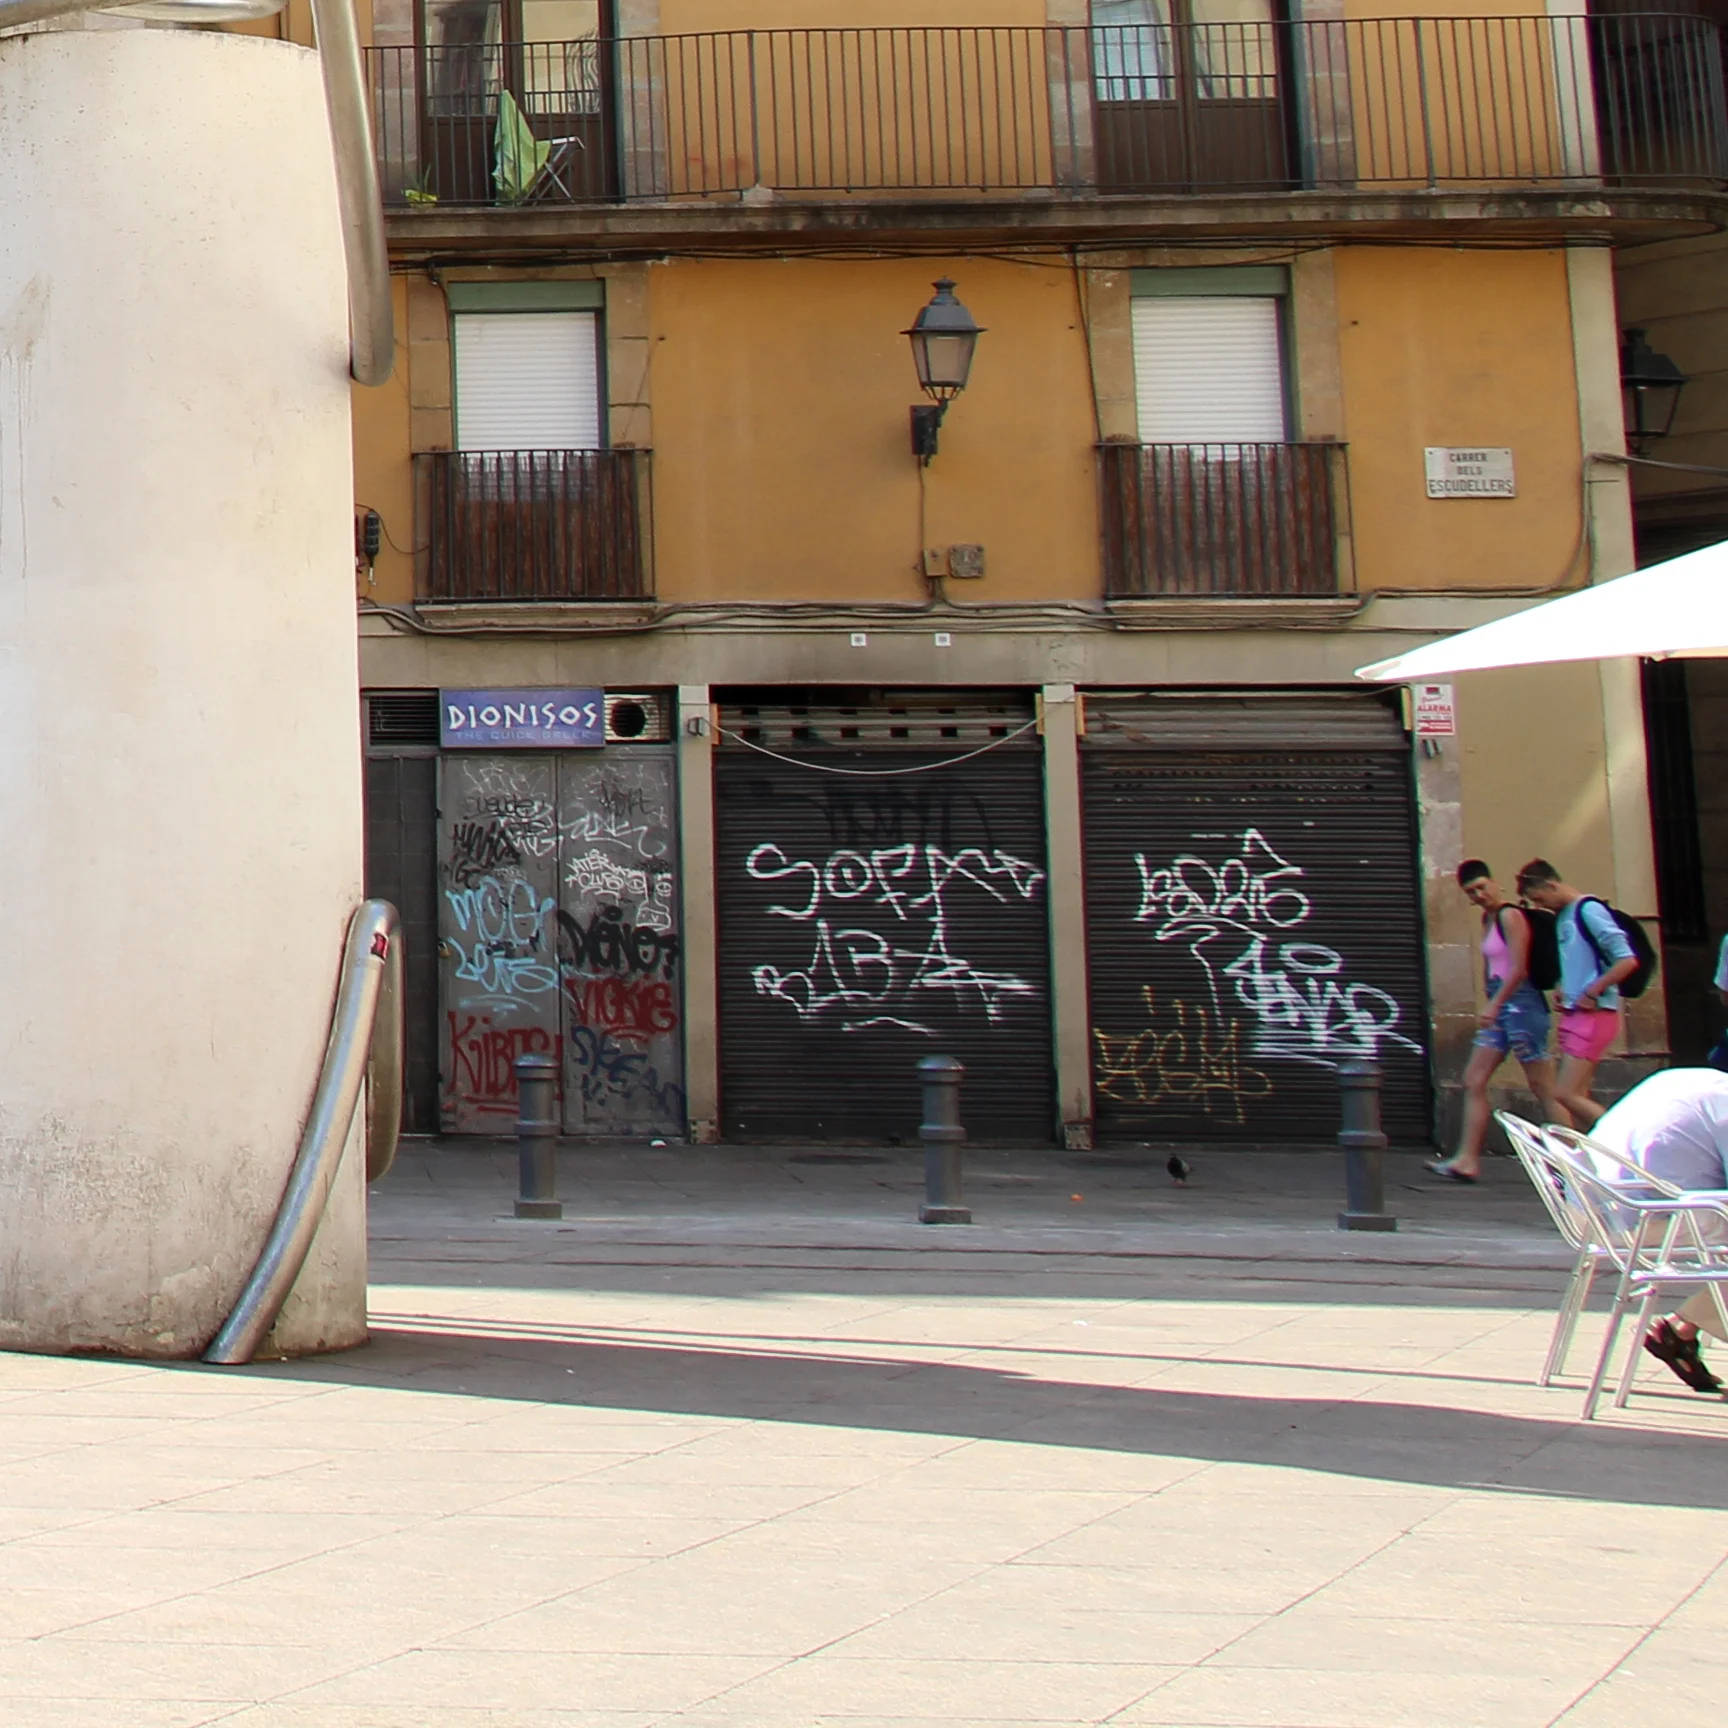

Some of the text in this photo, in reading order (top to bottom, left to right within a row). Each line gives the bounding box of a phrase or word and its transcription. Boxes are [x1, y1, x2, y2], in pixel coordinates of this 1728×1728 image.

[1449, 452, 1488, 463] CARRER
[1457, 465, 1483, 476] DELS
[1428, 479, 1513, 493] ESCUDELLERS
[447, 702, 598, 730] DIONISOS
